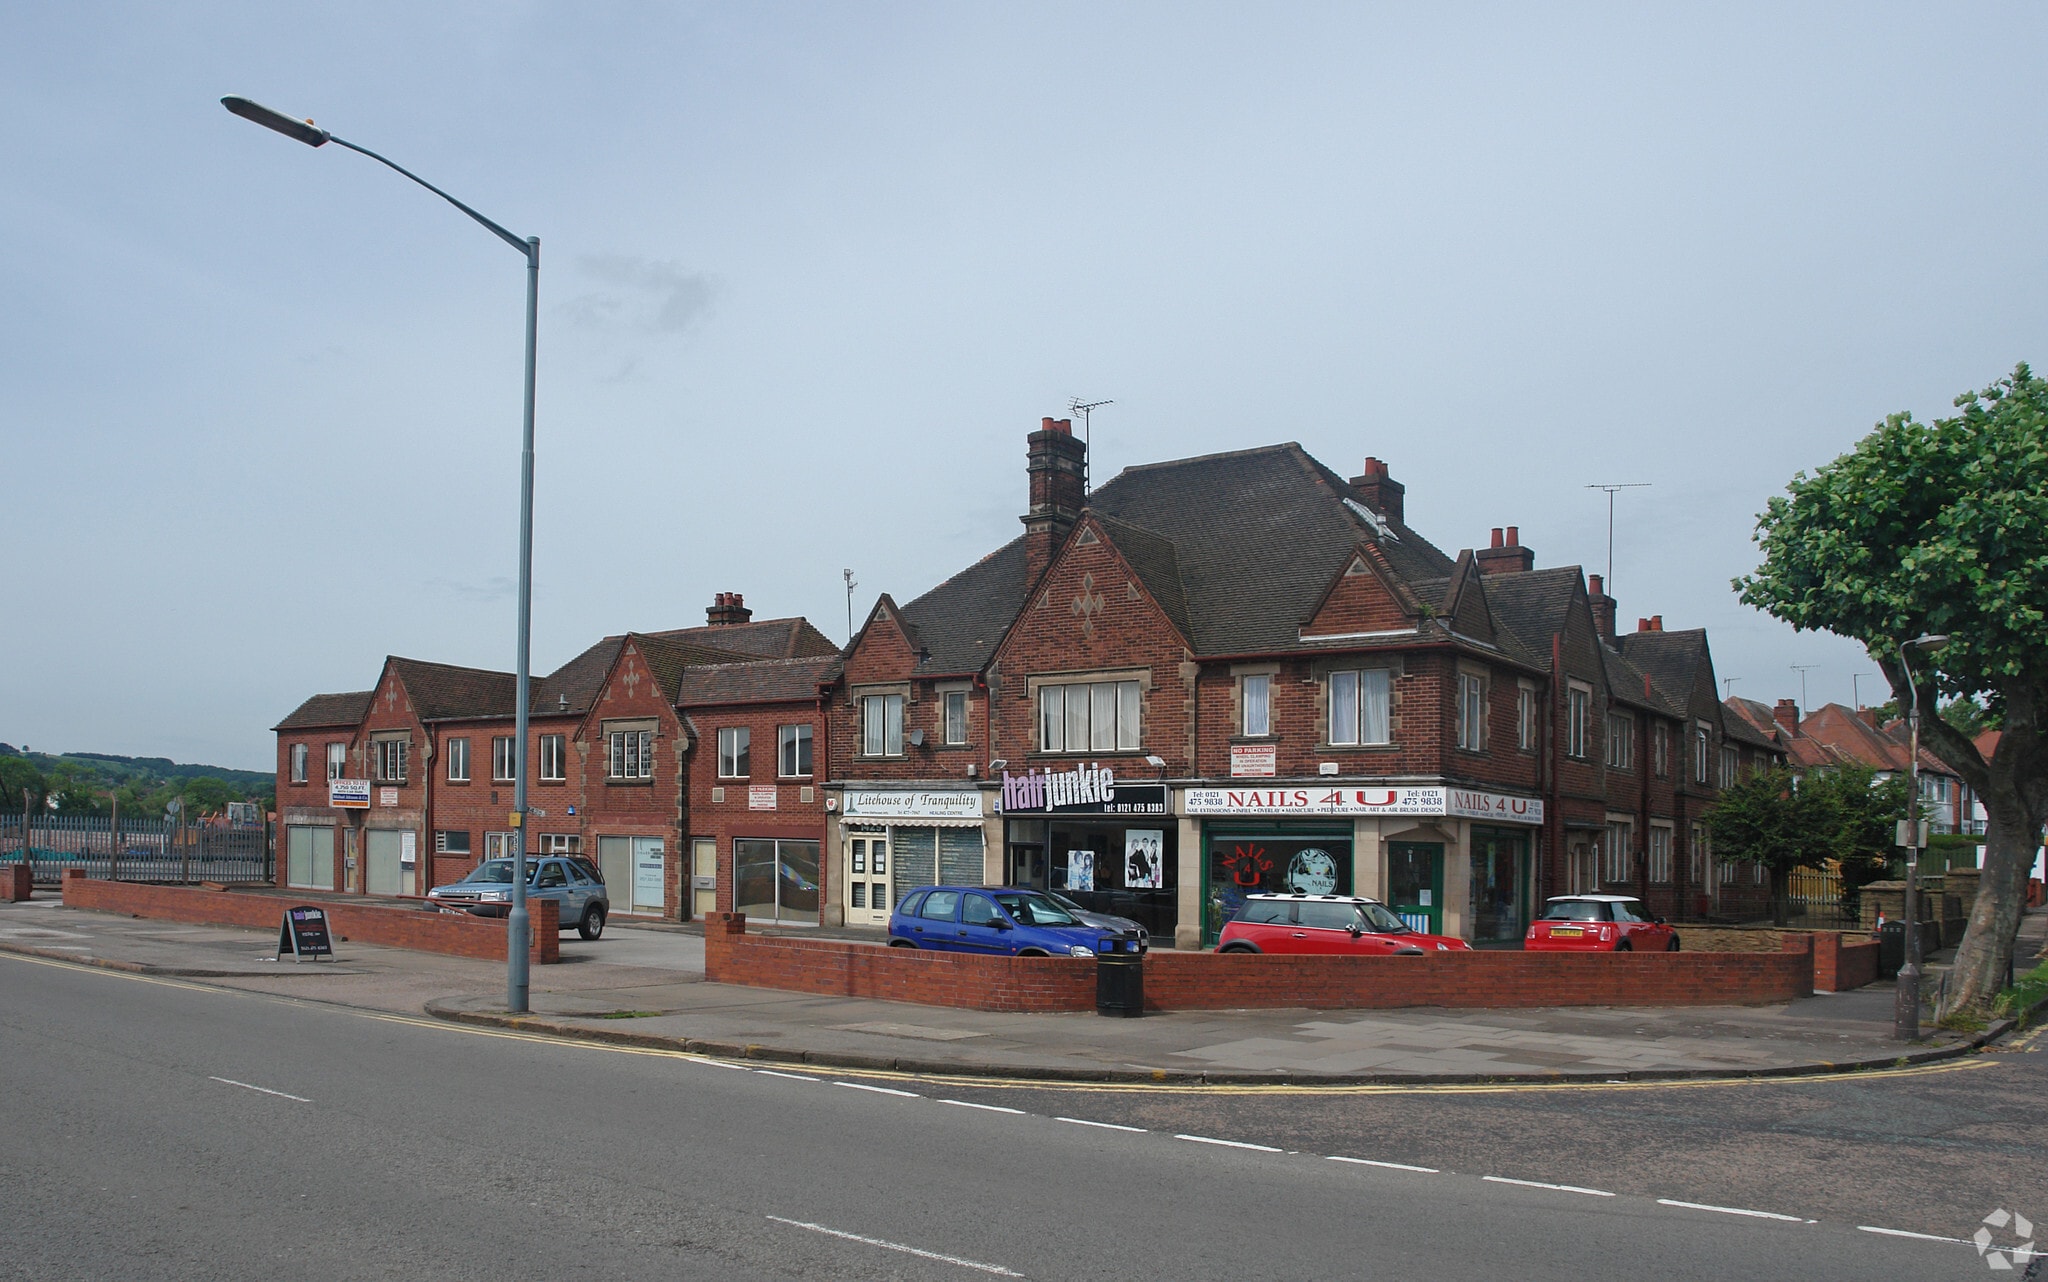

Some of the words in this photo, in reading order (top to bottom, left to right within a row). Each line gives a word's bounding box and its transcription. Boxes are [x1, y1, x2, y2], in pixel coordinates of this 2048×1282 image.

[857, 793, 901, 806] Litehouse
[904, 793, 916, 809] of
[921, 792, 976, 809] Tranquility
[1227, 790, 1309, 807] NAILS
[1319, 790, 1347, 806] 4
[1356, 790, 1397, 806] U
[1402, 797, 1417, 805] 475
[1420, 797, 1442, 805] 9838
[1454, 791, 1490, 812] NAILS
[1496, 797, 1506, 812] 4
[1511, 799, 1527, 815] U
[1117, 803, 1131, 812] 0121
[1133, 803, 1145, 812] 475
[1222, 843, 1274, 872] NAILS
[1243, 863, 1251, 873] 4
[1233, 871, 1260, 886] U
[1311, 879, 1334, 888] NAILS
